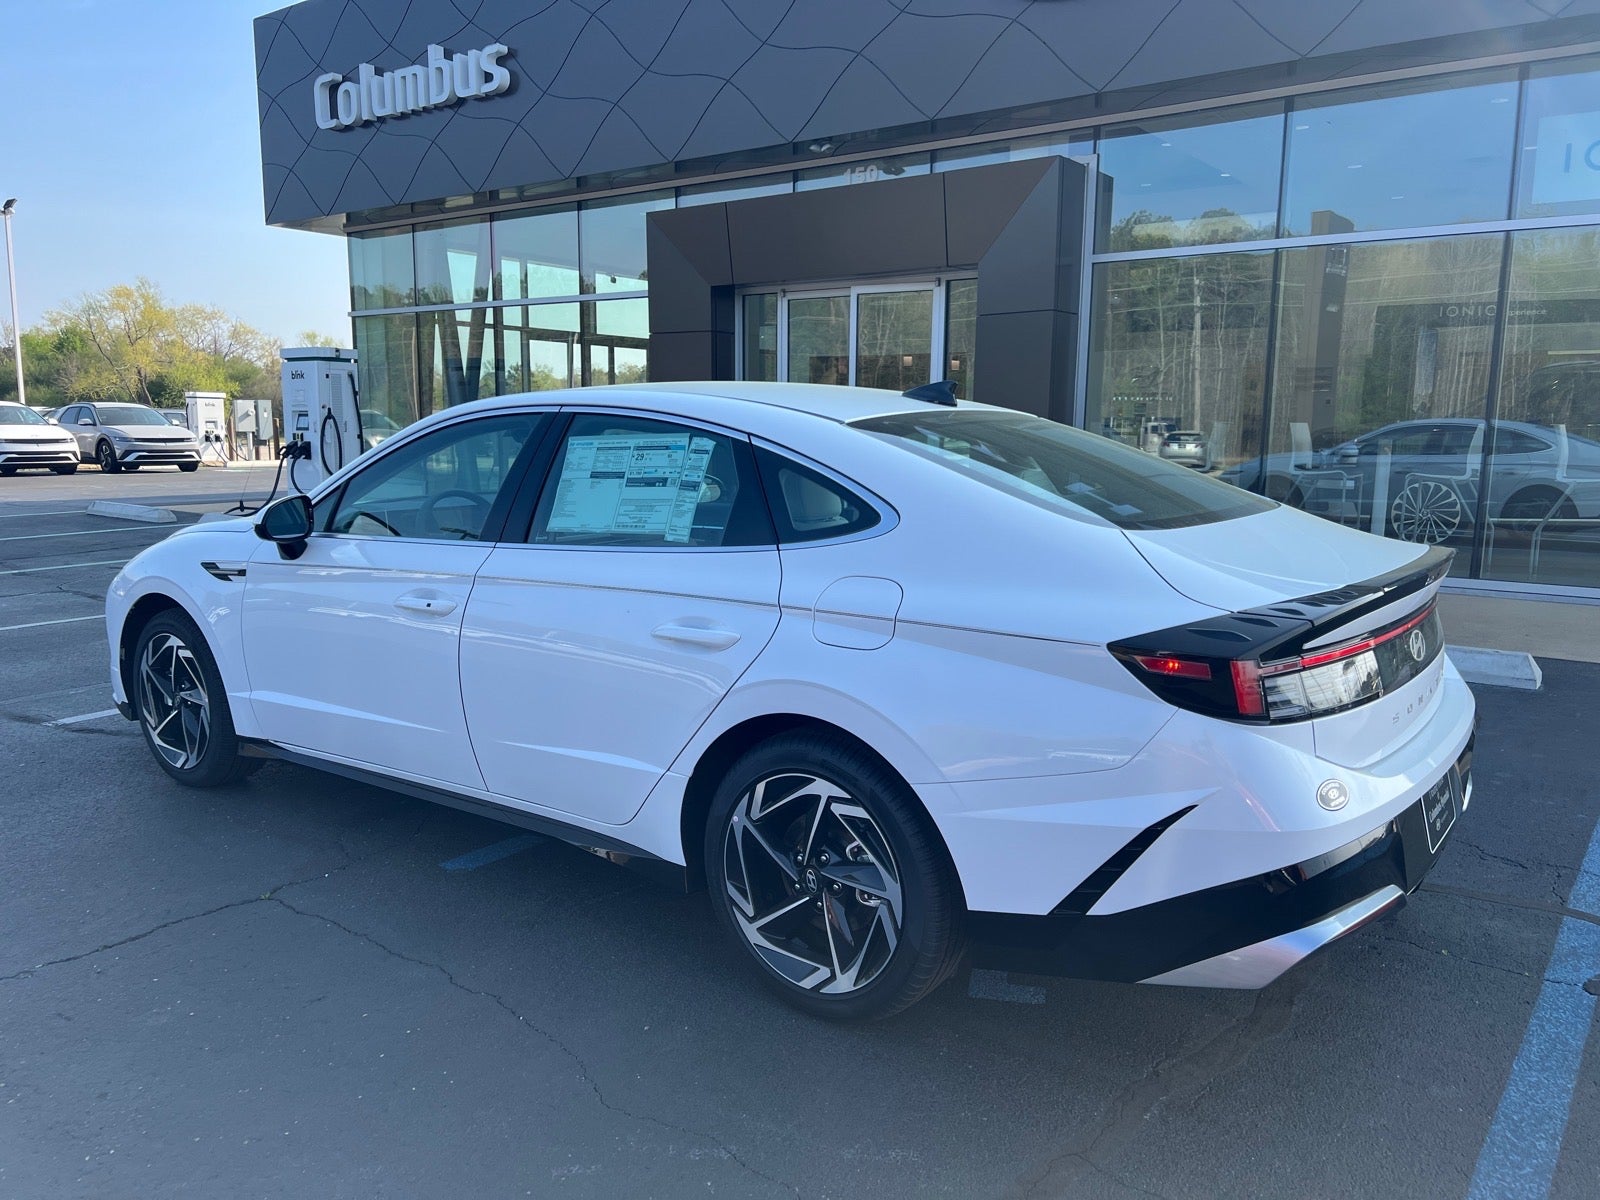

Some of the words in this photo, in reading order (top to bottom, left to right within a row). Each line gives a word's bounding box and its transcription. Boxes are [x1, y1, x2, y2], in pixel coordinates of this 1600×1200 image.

[313, 42, 511, 130] Columbus
[843, 165, 878, 185] 150
[291, 370, 305, 380] blink
